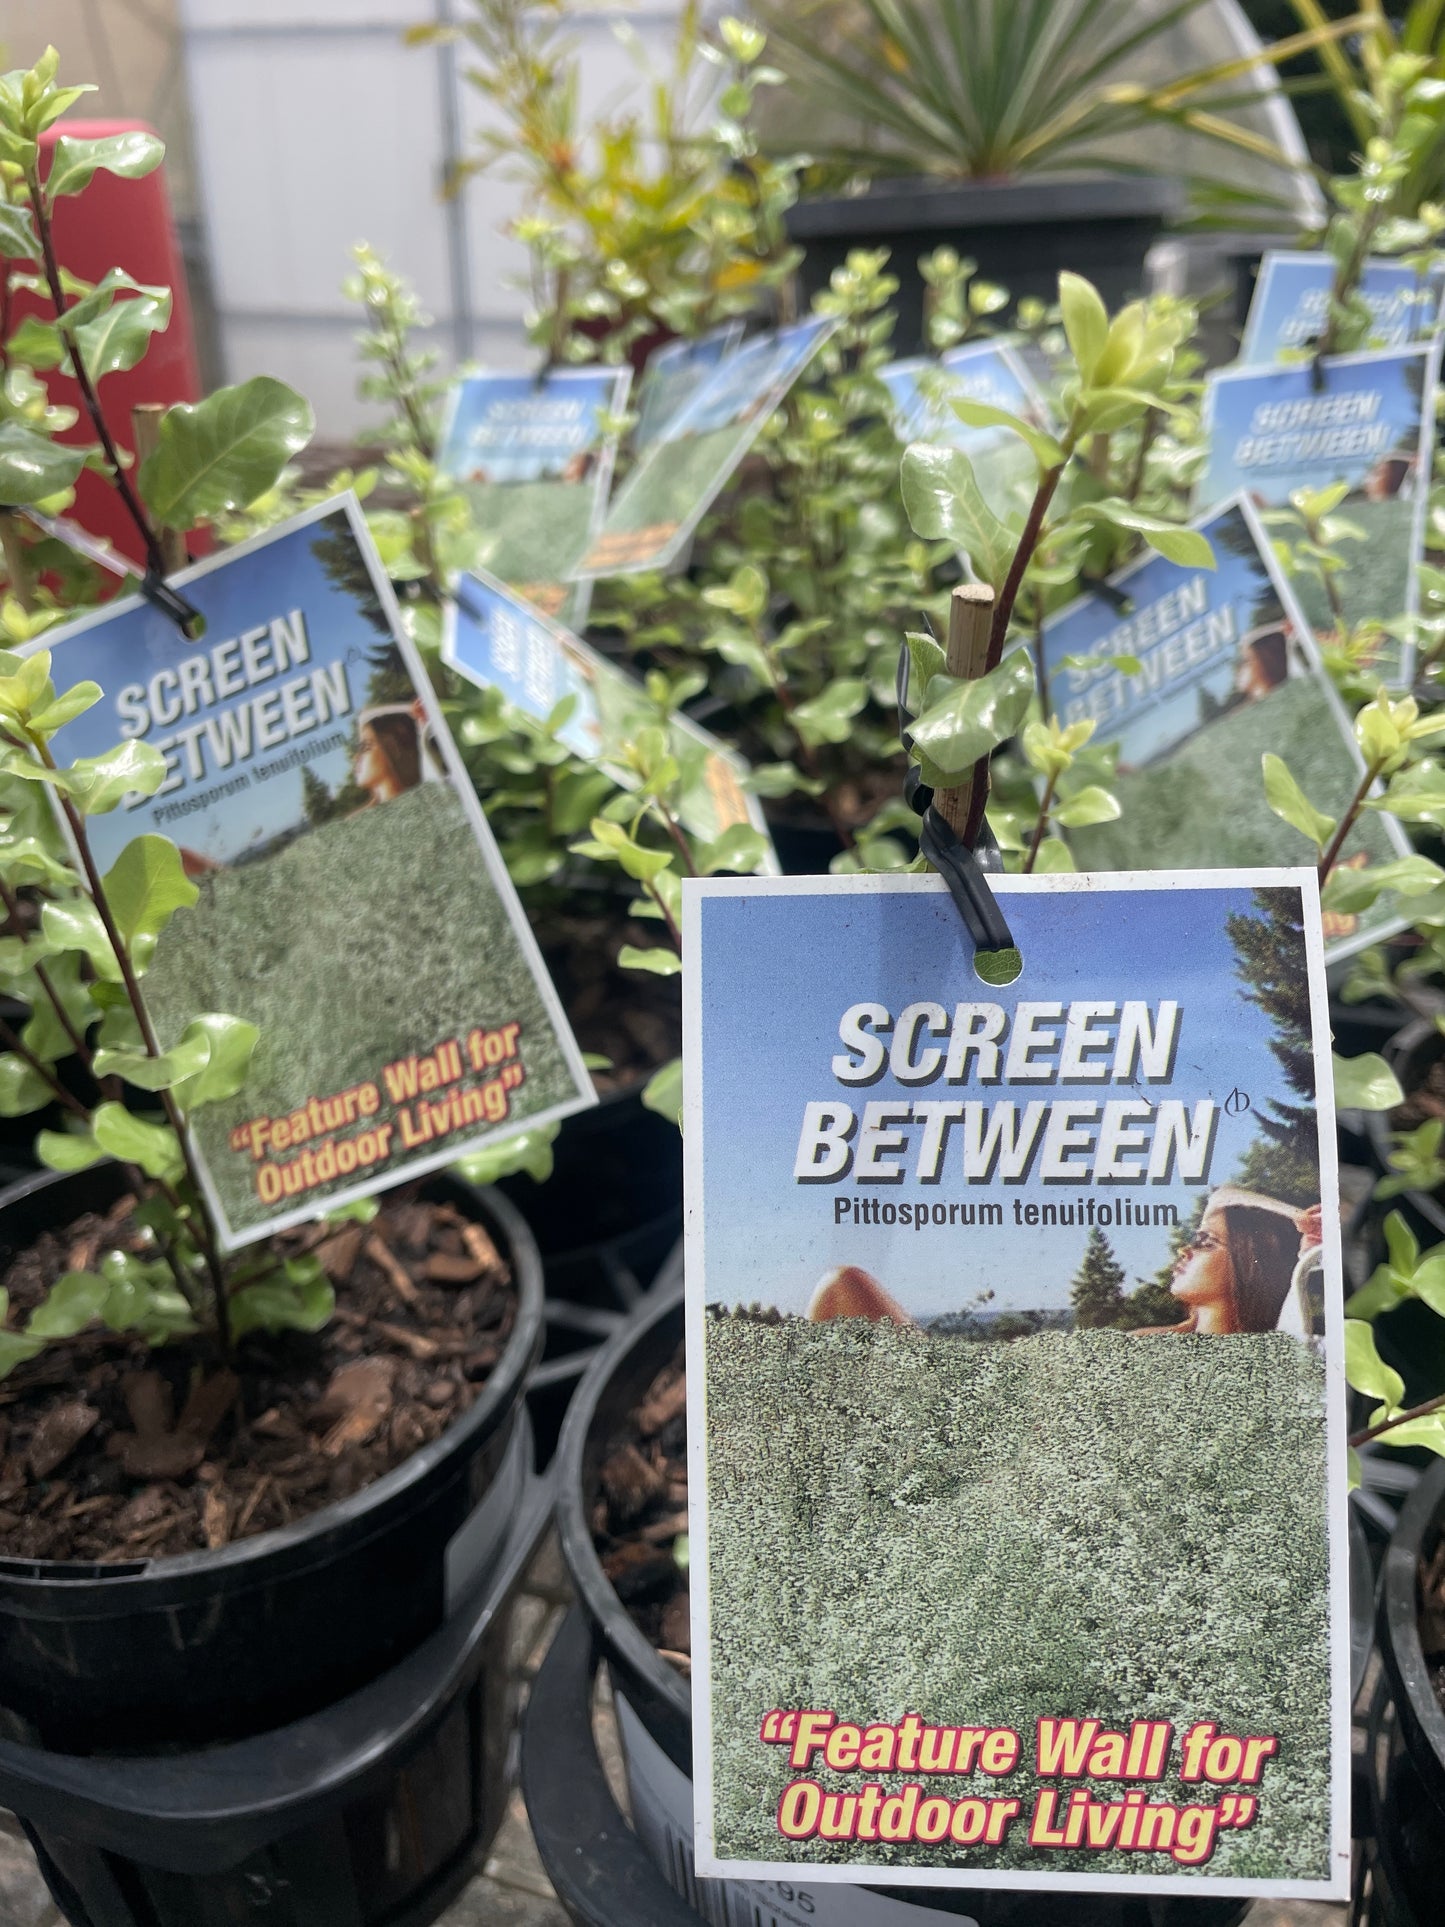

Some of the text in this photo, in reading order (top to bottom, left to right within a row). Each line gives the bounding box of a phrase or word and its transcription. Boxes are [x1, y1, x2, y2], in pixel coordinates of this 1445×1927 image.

[116, 608, 311, 740] SCREEN
[123, 660, 355, 812] ETWEEN
[383, 1041, 463, 1104] Wall
[467, 1022, 522, 1072] for
[832, 1000, 1184, 1086] SCREEN
[257, 1122, 393, 1205] Outdoor
[794, 1099, 1219, 1185] BETWEEN
[834, 1196, 1178, 1230] Pittosporum tenuifolium
[761, 1708, 1280, 1784] “Feature Wall for
[777, 1779, 1257, 1867] Outdoor Living”
